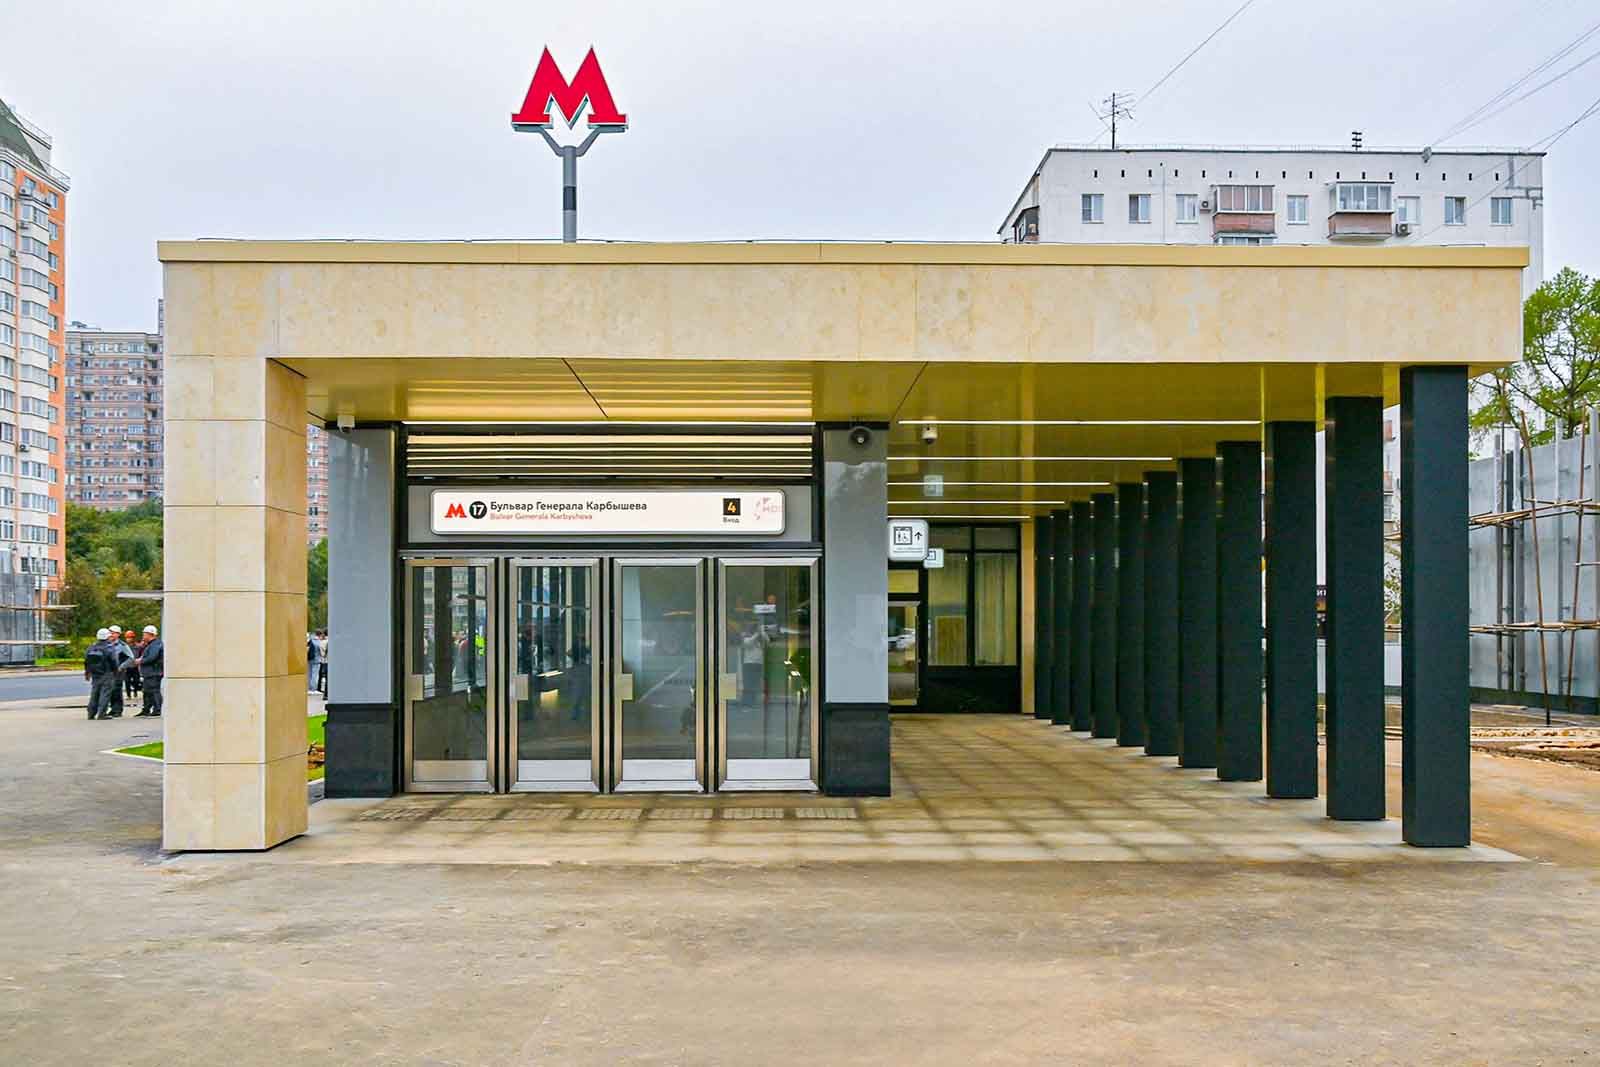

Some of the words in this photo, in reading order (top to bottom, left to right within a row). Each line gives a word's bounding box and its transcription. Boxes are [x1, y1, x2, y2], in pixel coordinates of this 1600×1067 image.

[511, 45, 628, 129] М
[444, 503, 467, 518] М
[490, 501, 534, 512] Бульвар
[536, 501, 583, 512] Генерала
[586, 501, 647, 512] Карбышева
